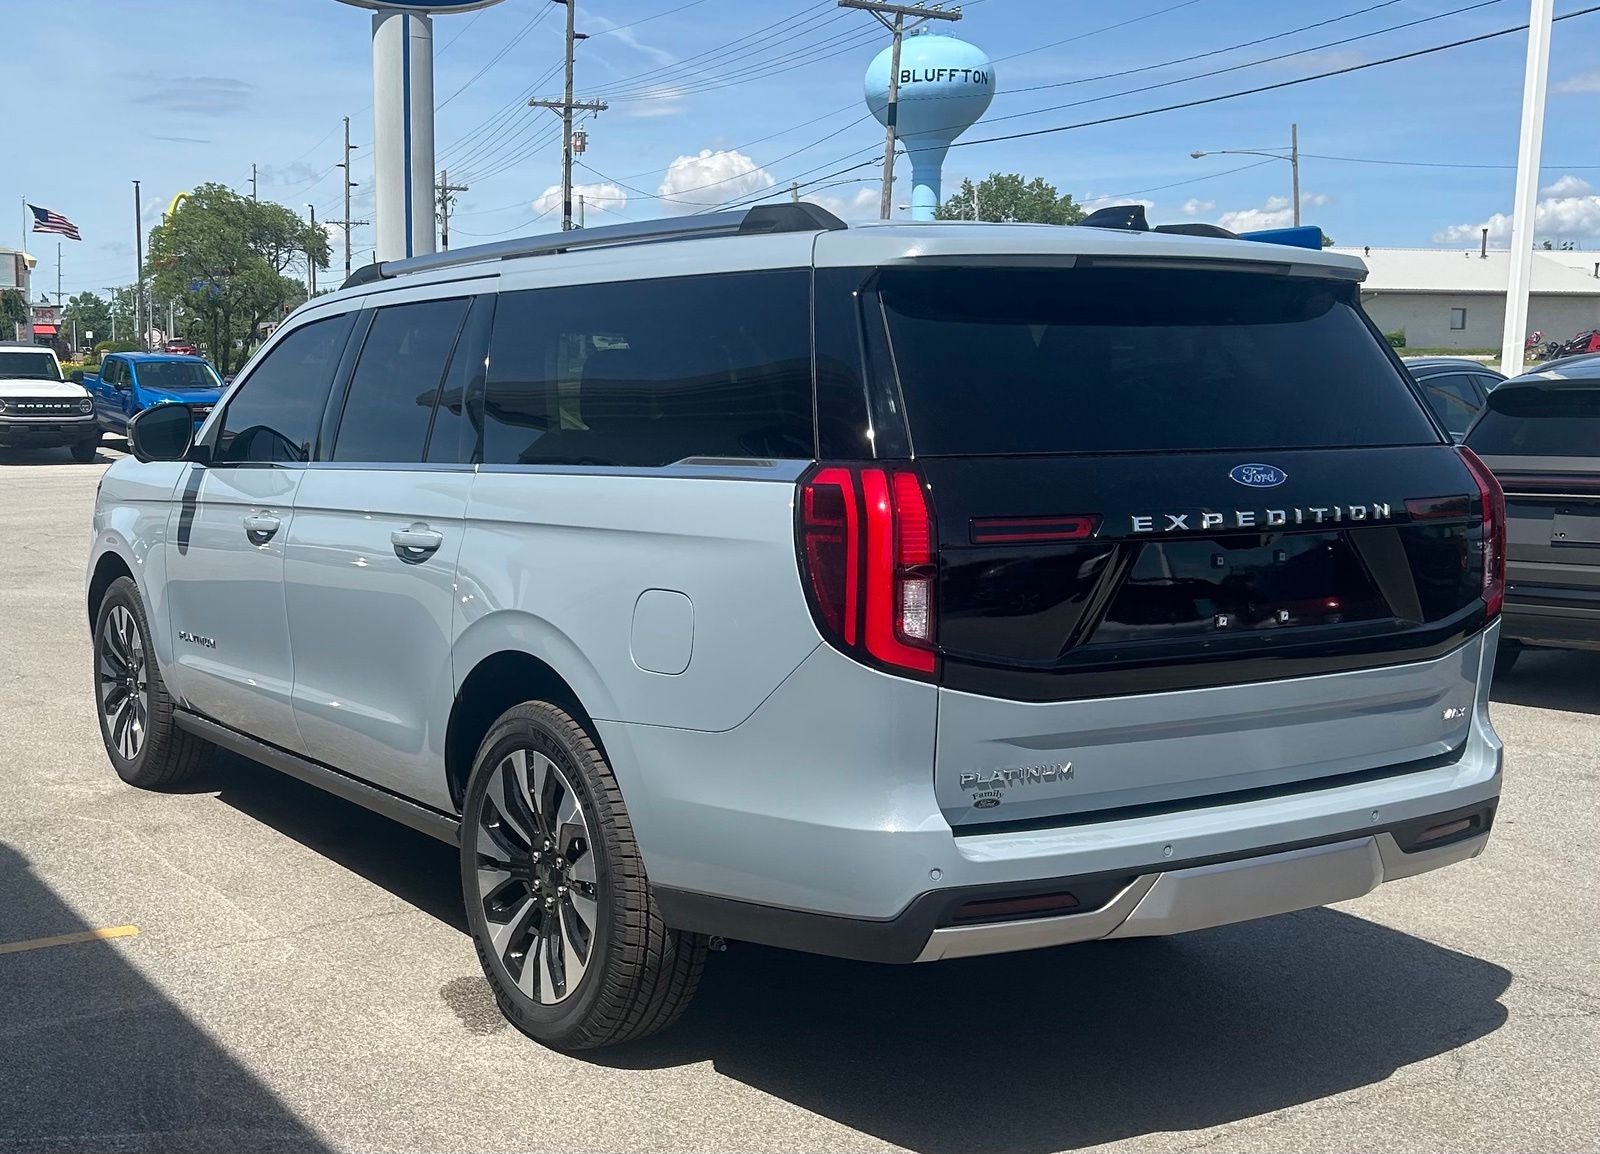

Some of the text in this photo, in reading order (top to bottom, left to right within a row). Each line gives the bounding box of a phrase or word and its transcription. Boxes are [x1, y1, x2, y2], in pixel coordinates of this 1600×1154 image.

[900, 68, 988, 85] BLUFFTON
[1242, 466, 1277, 484] Ford
[1131, 503, 1391, 532] EXPEDITION
[960, 761, 1073, 787] PLATINUM
[972, 789, 1003, 800] Family
